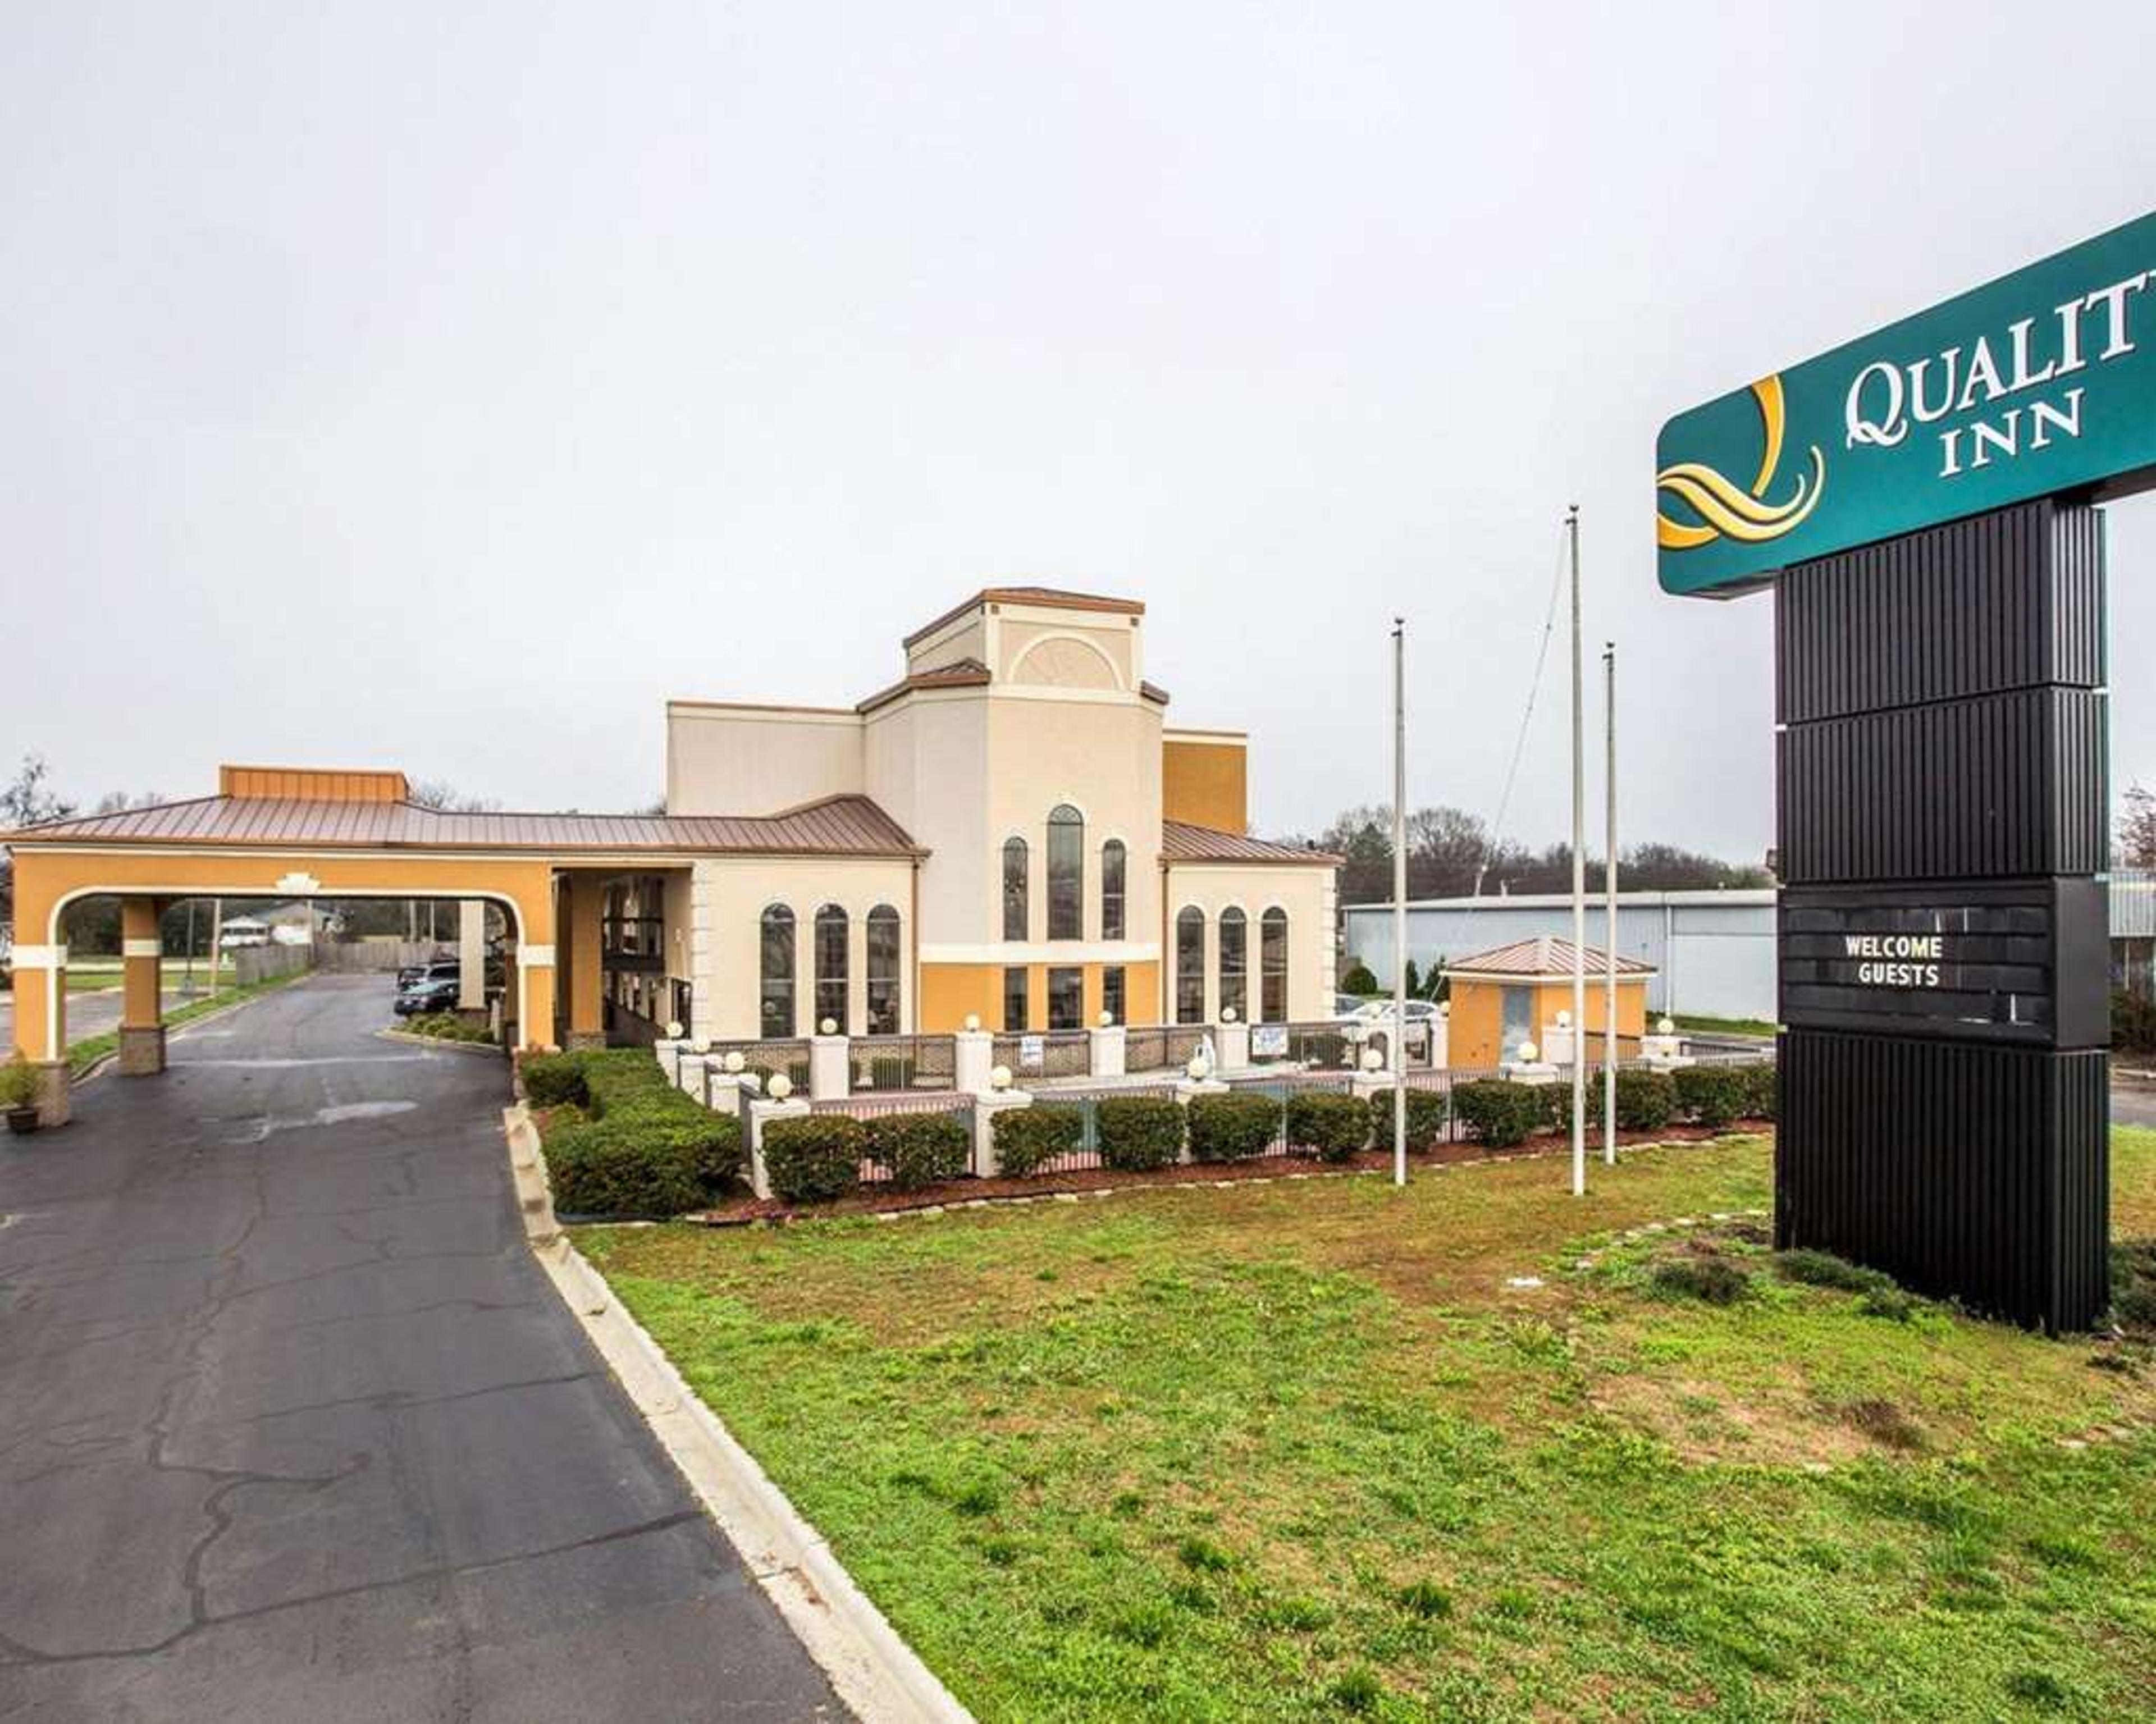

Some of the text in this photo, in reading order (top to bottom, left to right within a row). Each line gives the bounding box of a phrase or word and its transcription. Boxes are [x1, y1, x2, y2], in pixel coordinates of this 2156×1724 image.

[1846, 269, 2156, 449] QUALIT
[1939, 387, 2085, 477] INN
[1846, 934, 1943, 959] WELCOME
[1858, 962, 1939, 986] GUESTS
